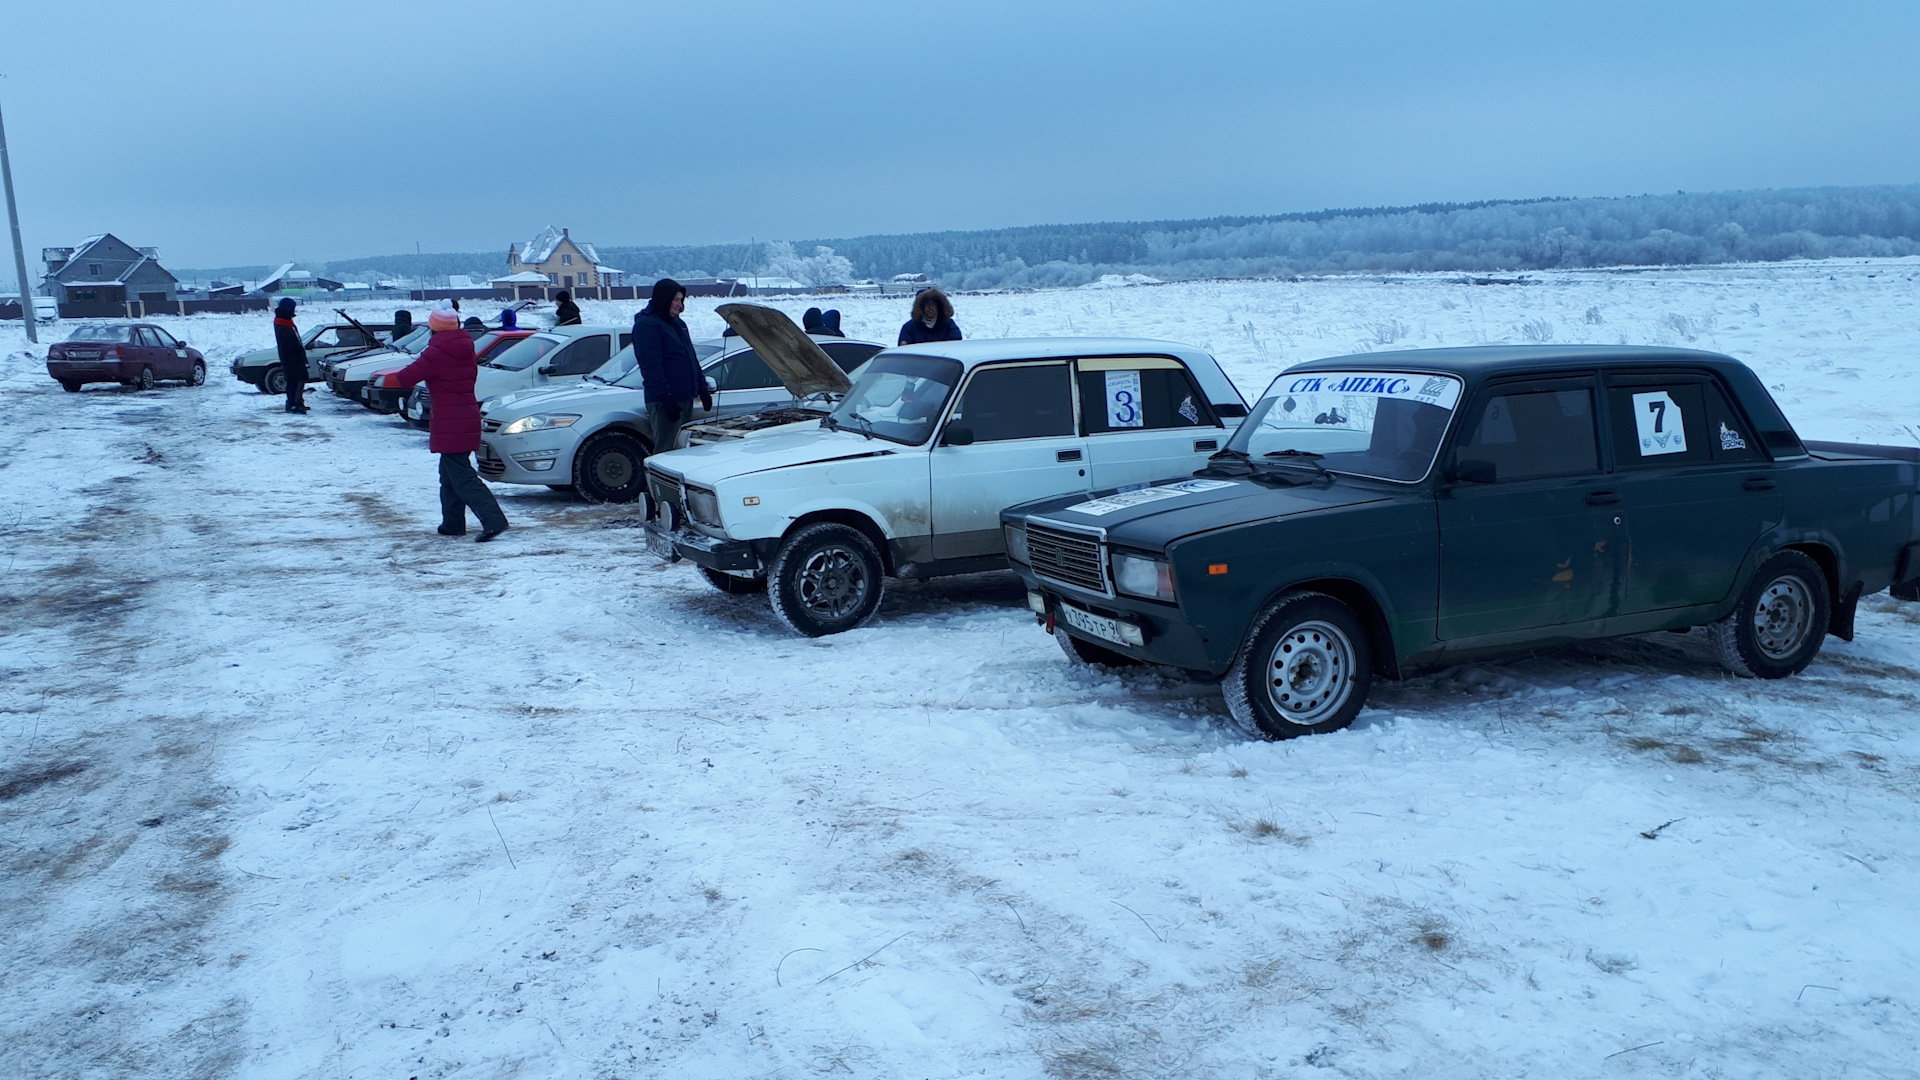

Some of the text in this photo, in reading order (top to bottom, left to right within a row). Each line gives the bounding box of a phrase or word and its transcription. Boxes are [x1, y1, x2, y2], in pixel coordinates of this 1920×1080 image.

[1289, 376, 1411, 395] СТК «АПЕКС»
[1115, 390, 1135, 423] 3
[1649, 400, 1666, 433] 7
